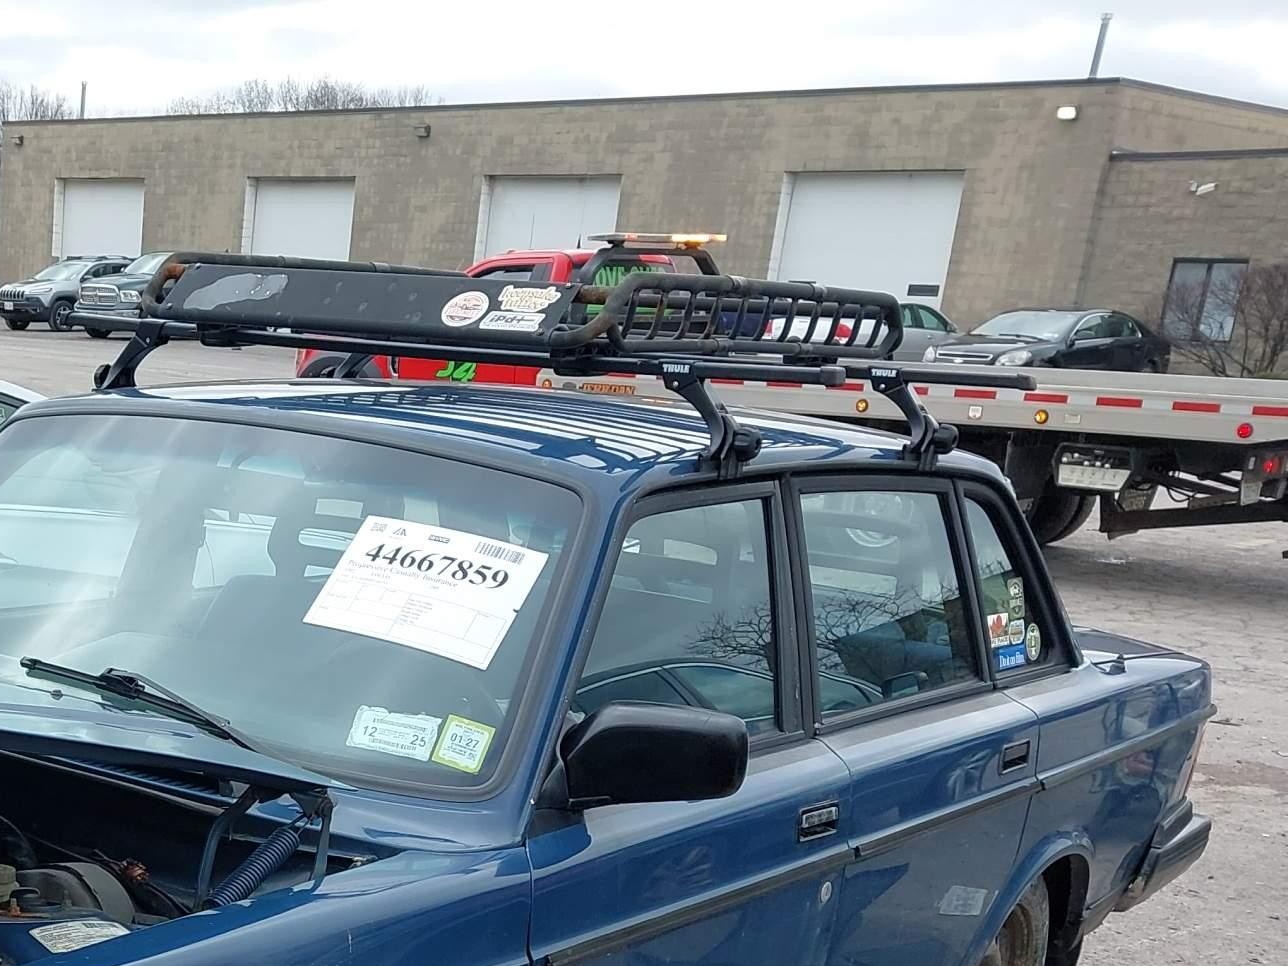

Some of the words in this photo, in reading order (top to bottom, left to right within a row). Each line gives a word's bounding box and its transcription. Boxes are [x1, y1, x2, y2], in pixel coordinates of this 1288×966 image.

[662, 363, 691, 374] THULE
[871, 368, 898, 378] THULE
[365, 543, 509, 589] 44667859
[362, 725, 378, 738] 12
[409, 734, 426, 748] 25
